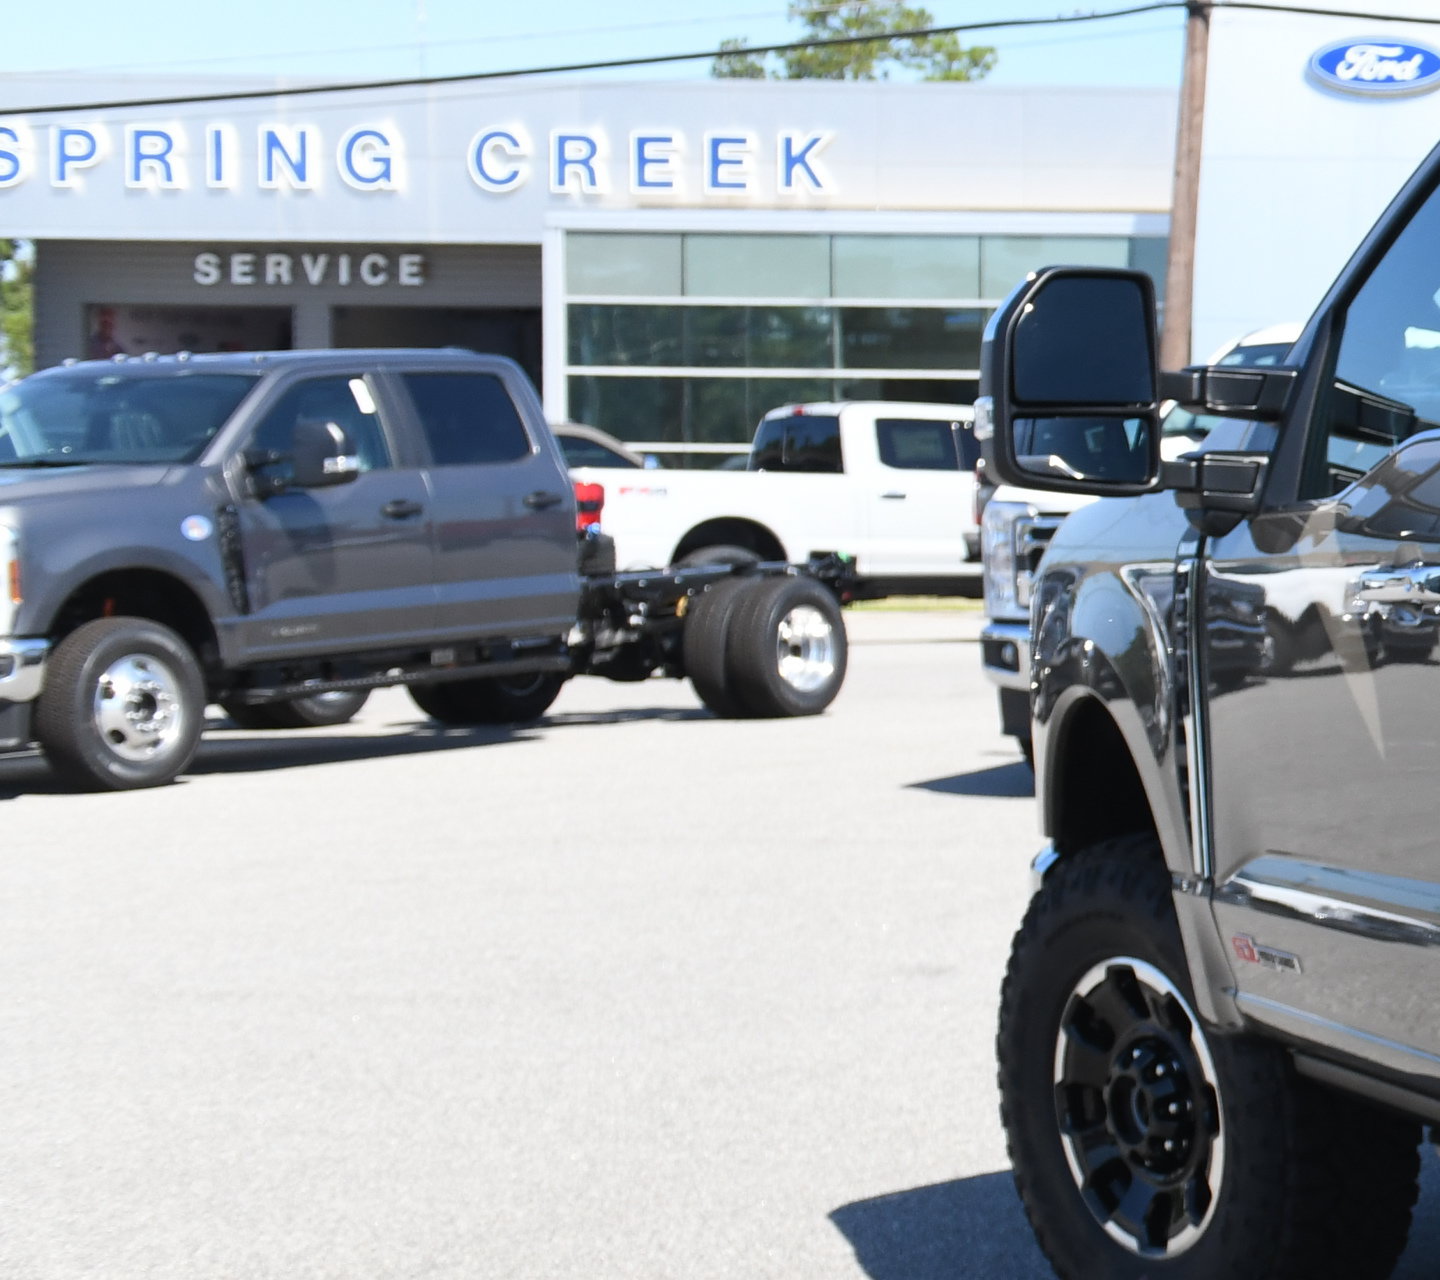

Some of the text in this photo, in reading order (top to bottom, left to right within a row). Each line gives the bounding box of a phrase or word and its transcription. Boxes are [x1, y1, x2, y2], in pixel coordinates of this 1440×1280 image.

[1335, 44, 1425, 81] Ford
[474, 130, 824, 189] CREEK
[193, 252, 427, 287] SERVICE
